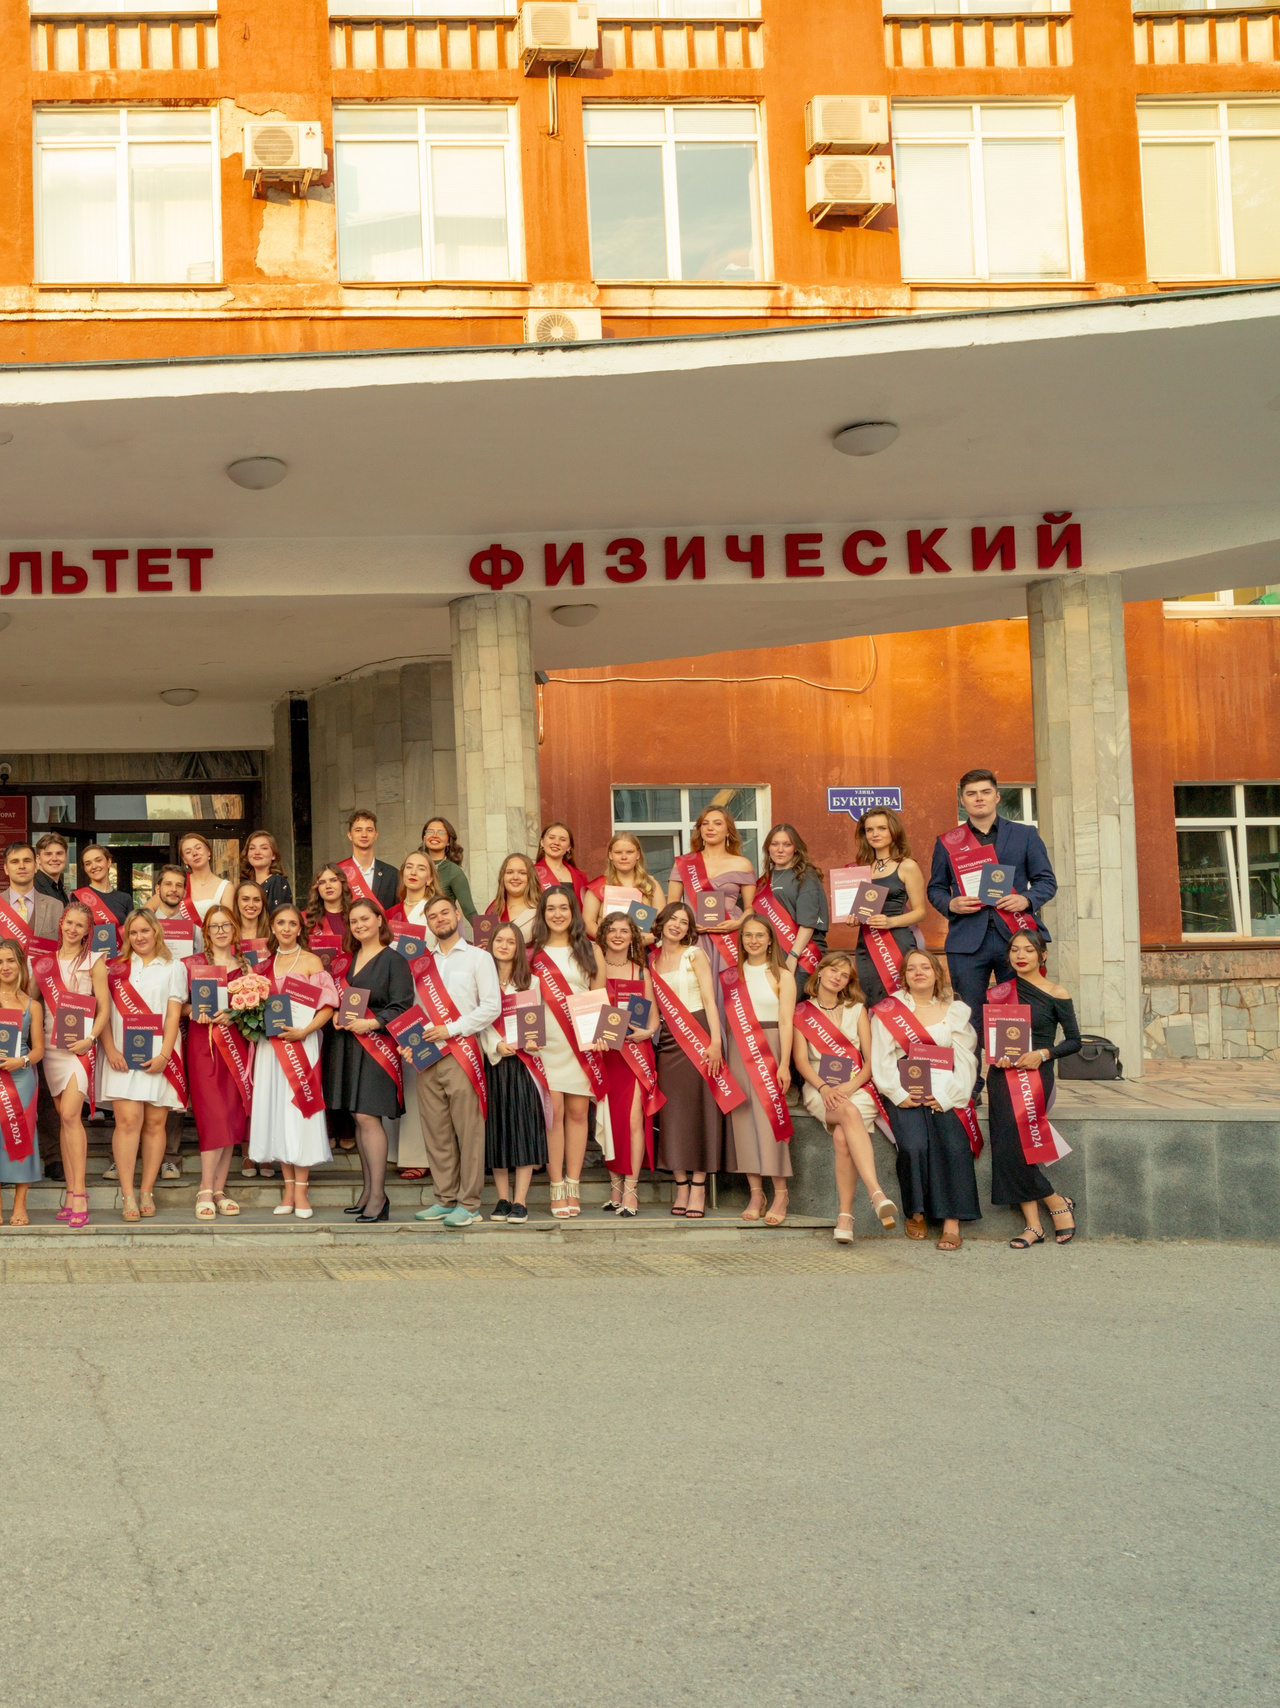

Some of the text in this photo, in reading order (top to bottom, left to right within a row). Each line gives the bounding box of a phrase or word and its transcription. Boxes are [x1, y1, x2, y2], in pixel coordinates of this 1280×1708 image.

[469, 512, 1084, 591] ФИЗИЧЕСКИЙ
[832, 796, 899, 806] БУКИРЕВА
[759, 897, 791, 935] ЛУЧШИЙ
[422, 974, 450, 1019] ЛУЧШИЙ
[533, 961, 568, 1004] ЛУЧШИЙ
[805, 1016, 846, 1059] ЛУЧШИЙ
[730, 988, 785, 1125] ЛУЧШИЙ ВЫПУСКНИК 2024
[590, 1064, 603, 1085] 2024
[714, 1074, 732, 1097] 2024
[301, 1080, 314, 1102] 2024
[10, 1118, 22, 1145] 2024
[1029, 1124, 1043, 1148] 2024
